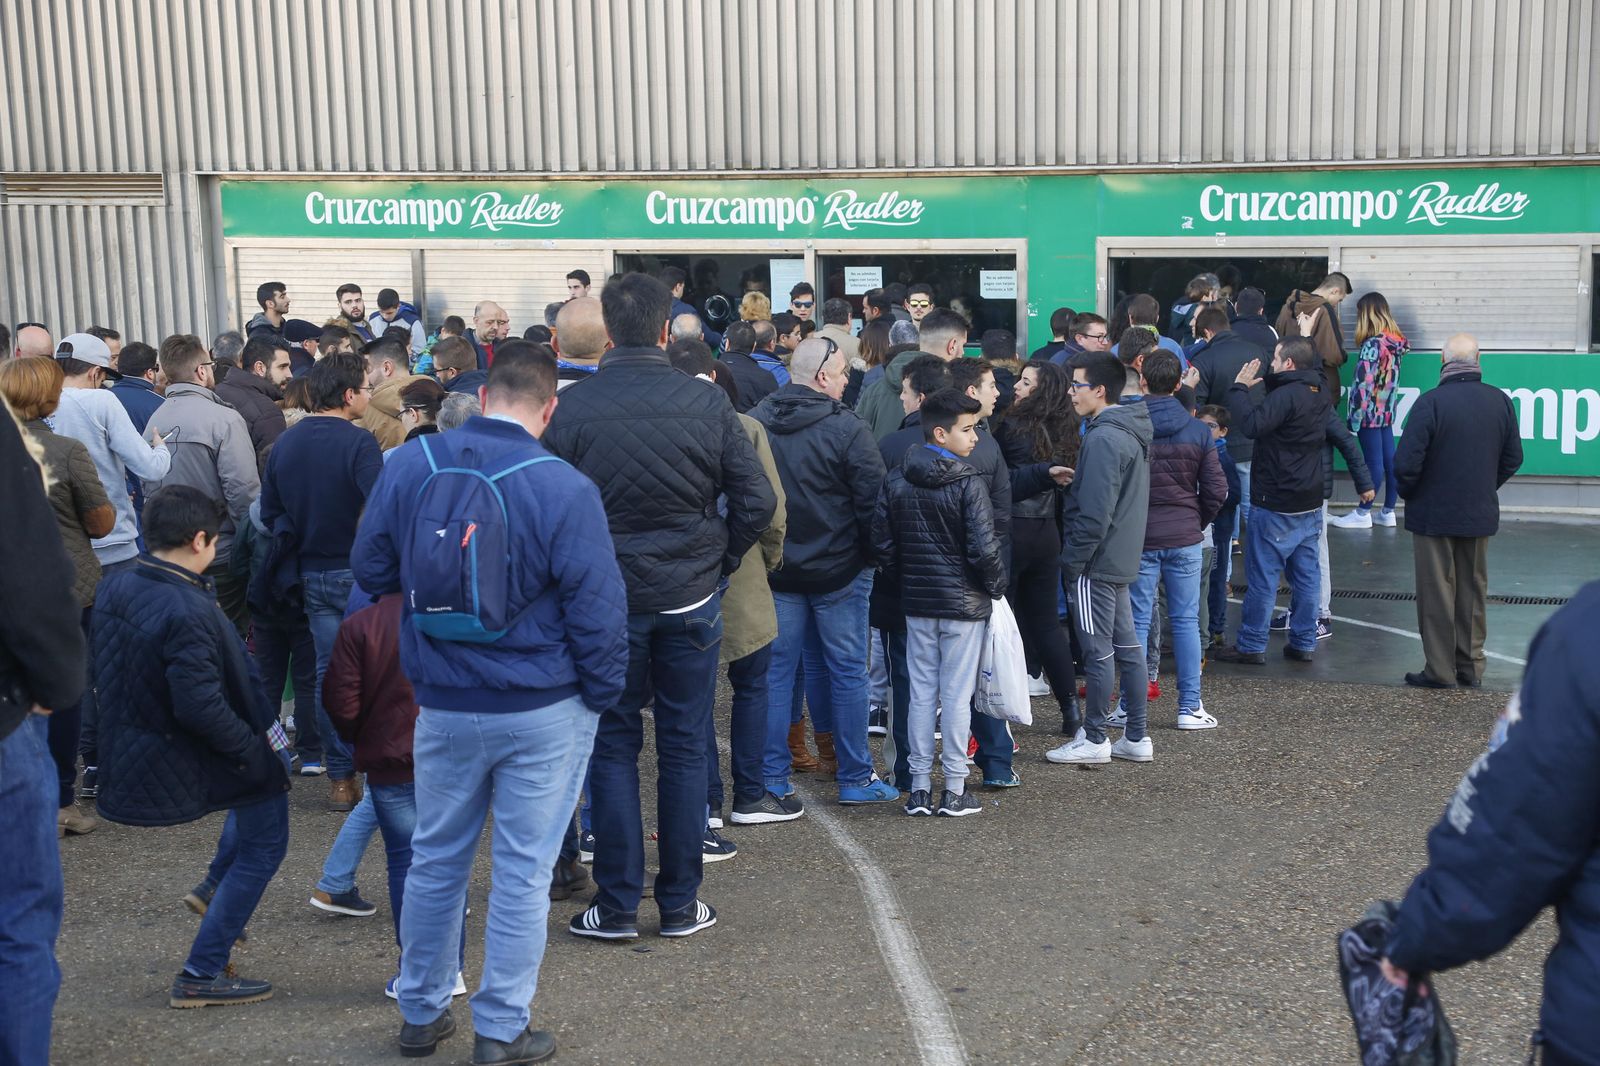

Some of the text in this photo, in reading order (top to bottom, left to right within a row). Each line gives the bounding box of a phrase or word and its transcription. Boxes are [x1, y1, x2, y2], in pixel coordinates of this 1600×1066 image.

[304, 191, 564, 232] Cruzcampo Radler
[645, 189, 925, 231] Cruzcampo Radler
[1200, 181, 1531, 227] Cruzcampo Radler
